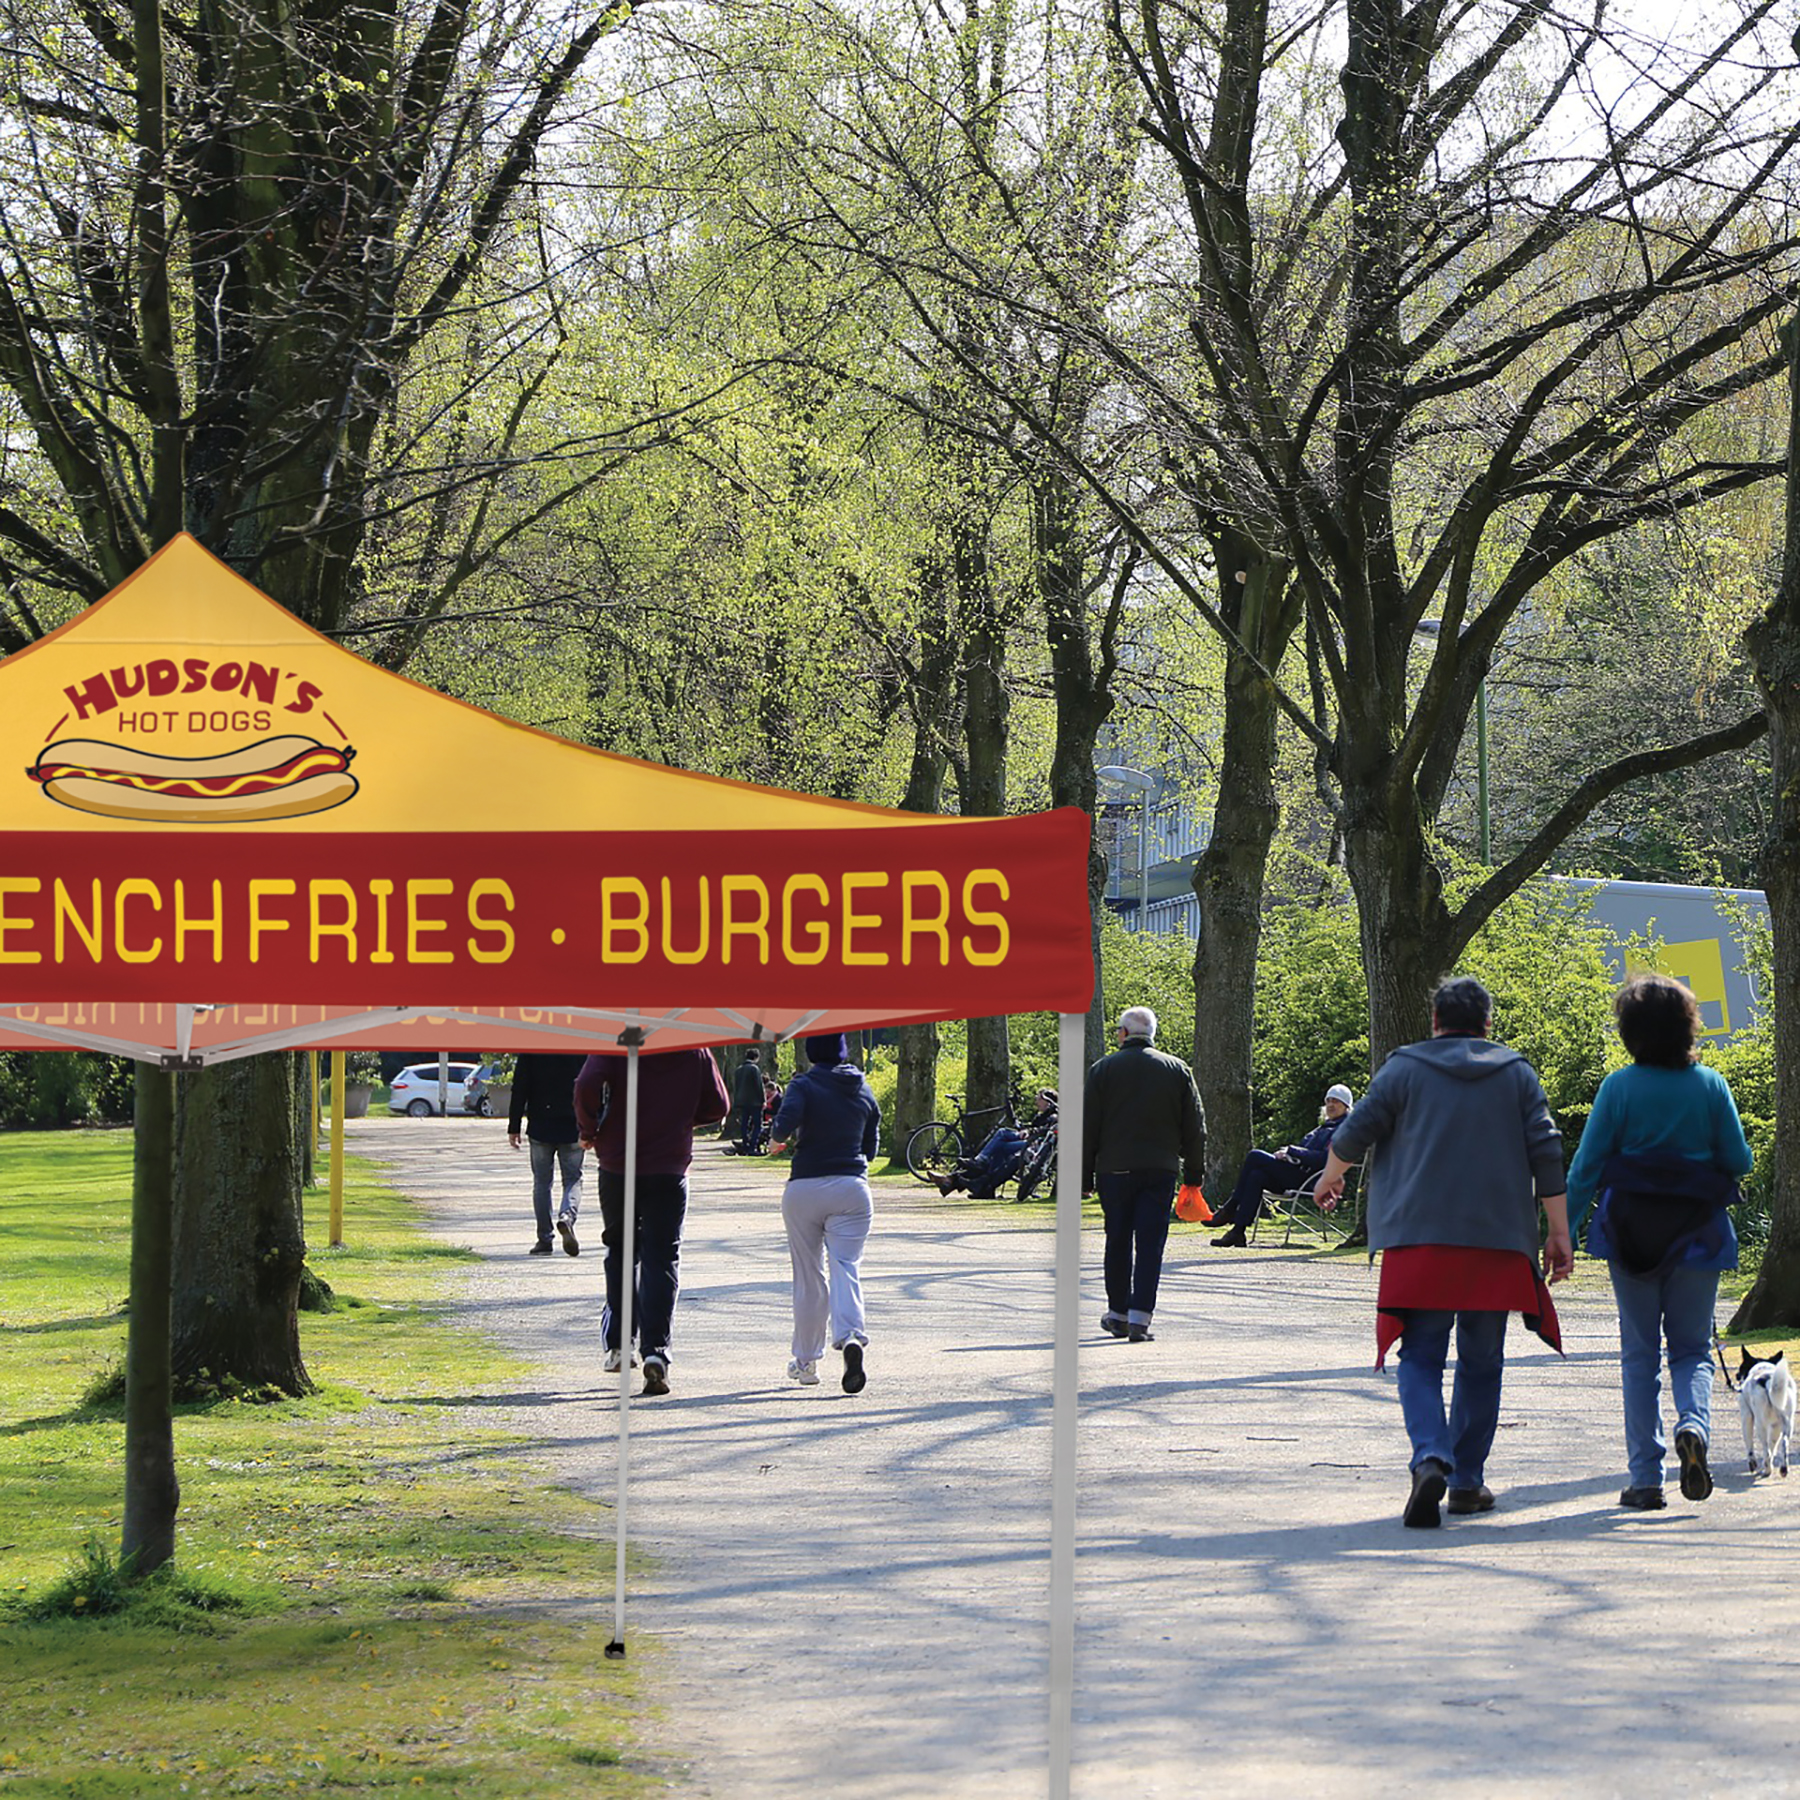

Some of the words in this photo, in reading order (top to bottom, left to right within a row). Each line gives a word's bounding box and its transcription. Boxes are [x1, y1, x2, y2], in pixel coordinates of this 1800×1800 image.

[63, 658, 324, 720] HUDSON'S
[118, 711, 179, 733] HOT
[188, 710, 271, 733] DOGS
[0, 877, 223, 964] ENCH
[249, 878, 515, 964] FRIES
[601, 868, 1010, 966] BURGERS
